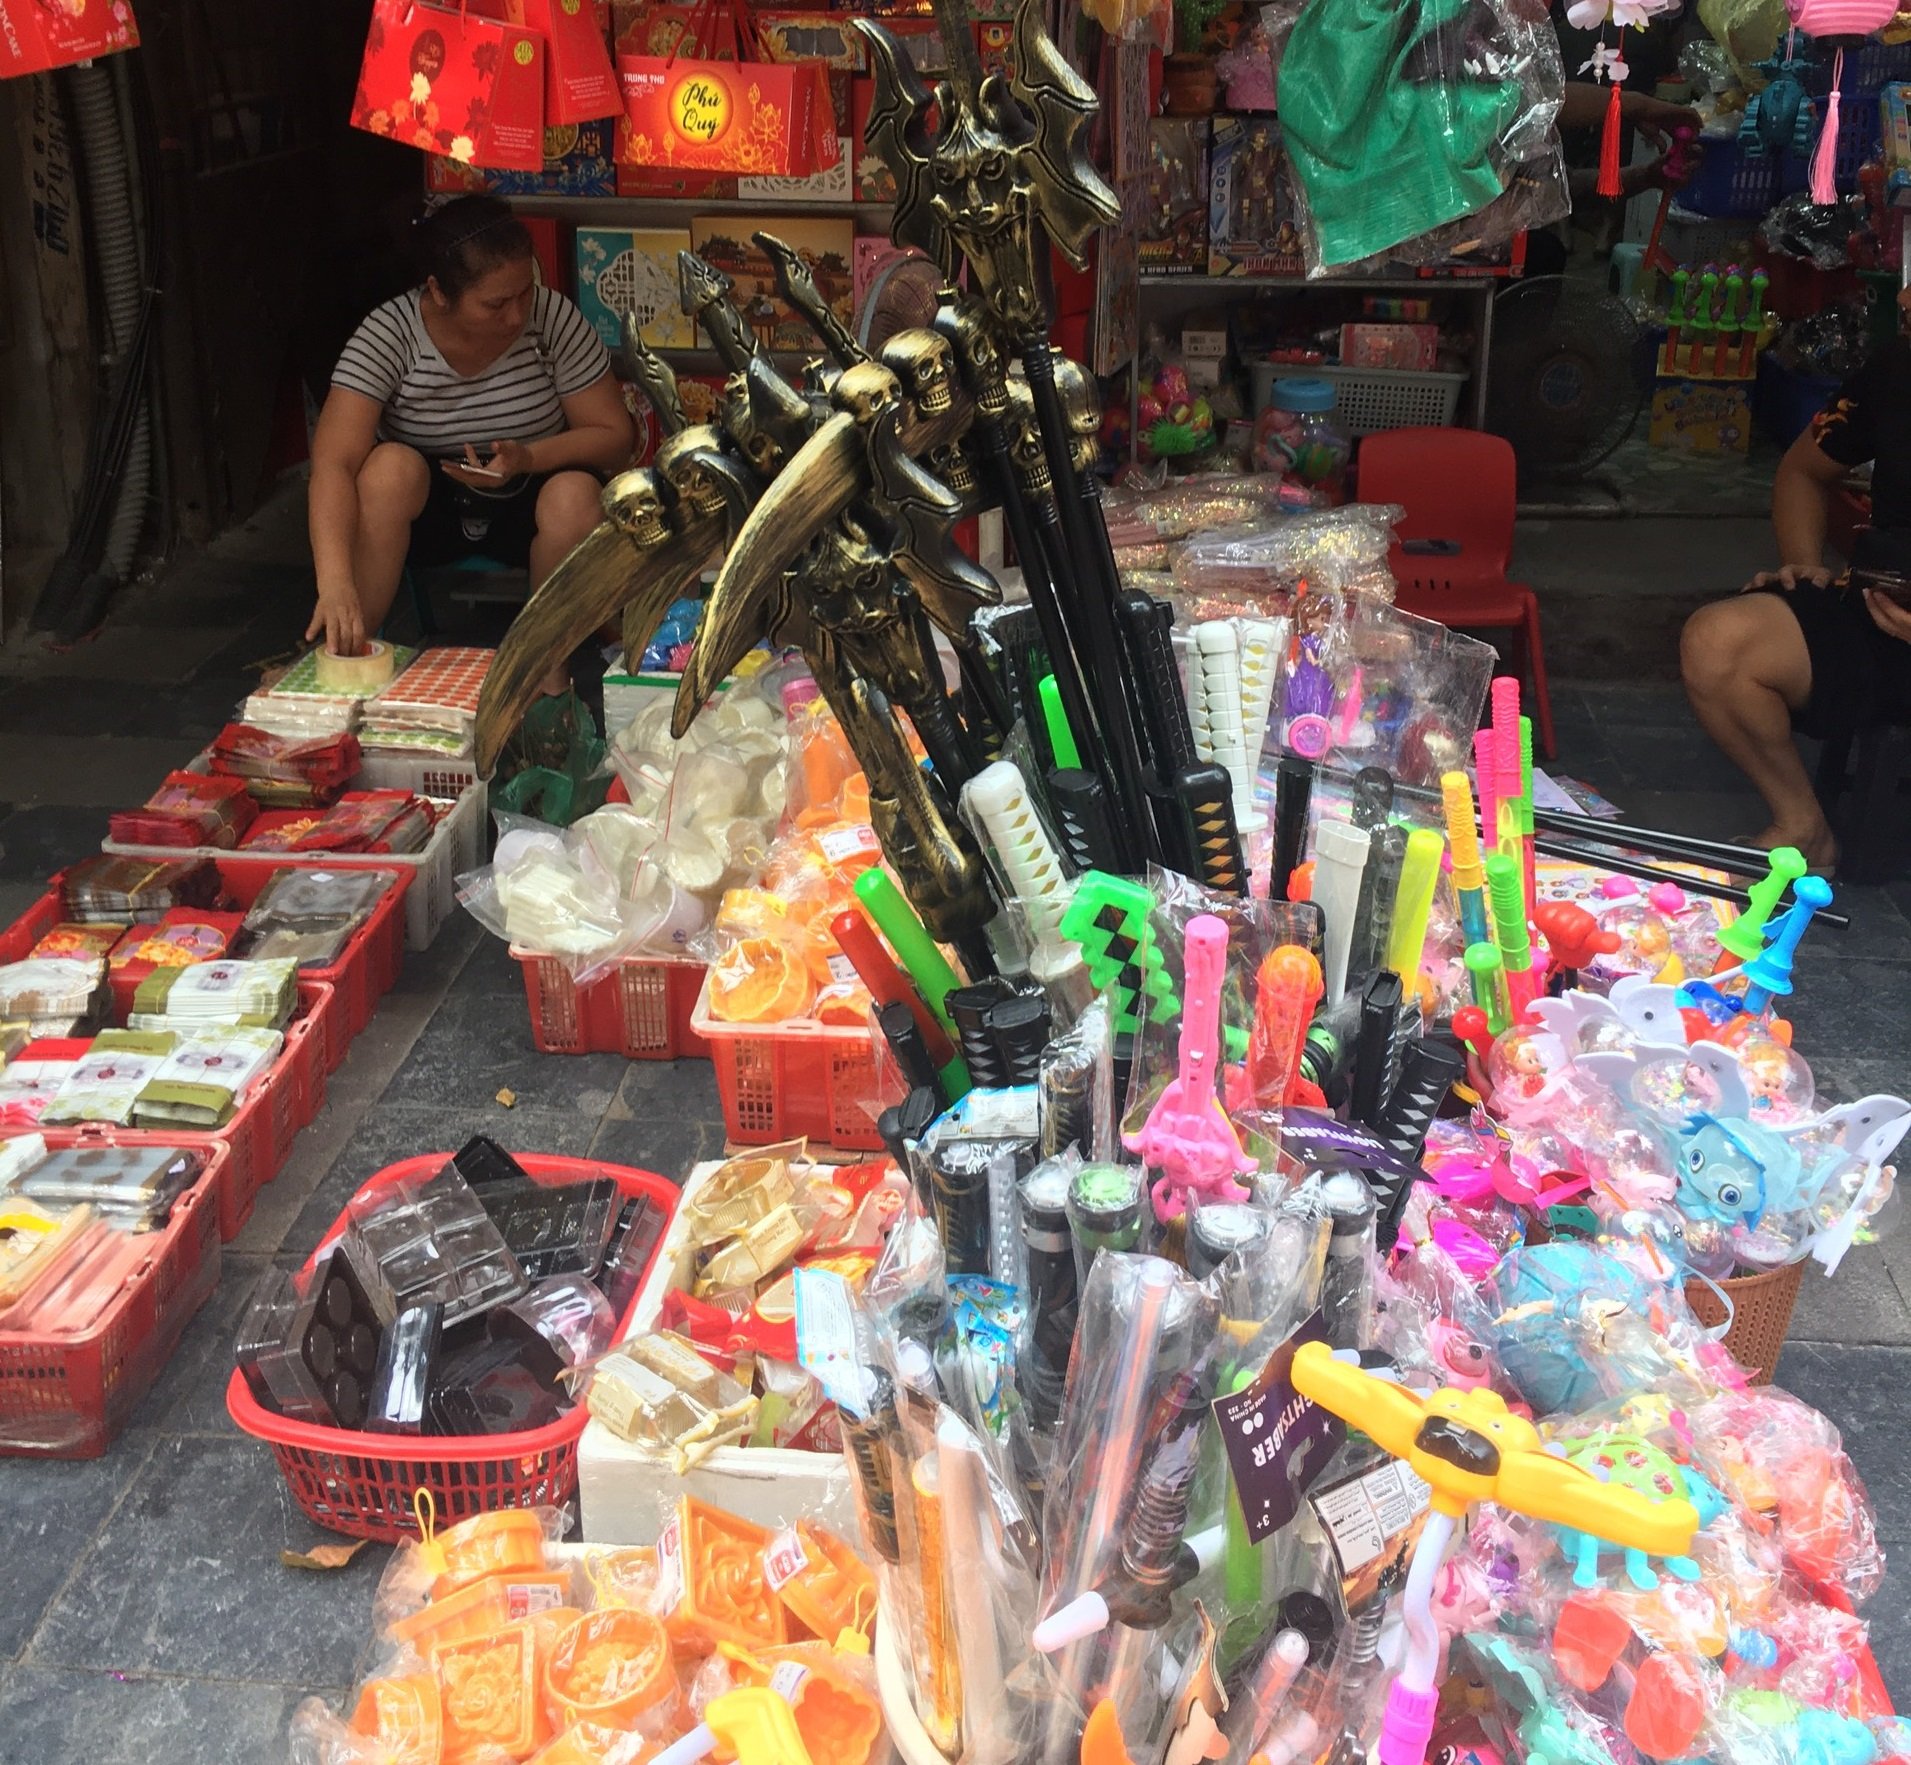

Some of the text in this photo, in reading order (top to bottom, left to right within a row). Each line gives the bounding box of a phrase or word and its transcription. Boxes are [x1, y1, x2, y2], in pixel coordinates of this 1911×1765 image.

[682, 80, 721, 109] Phú
[682, 107, 720, 140] Quý
[1230, 1407, 1249, 1423] CHINA
[1252, 1395, 1314, 1468] GHTSABER
[1256, 1513, 1271, 1530] 3+
